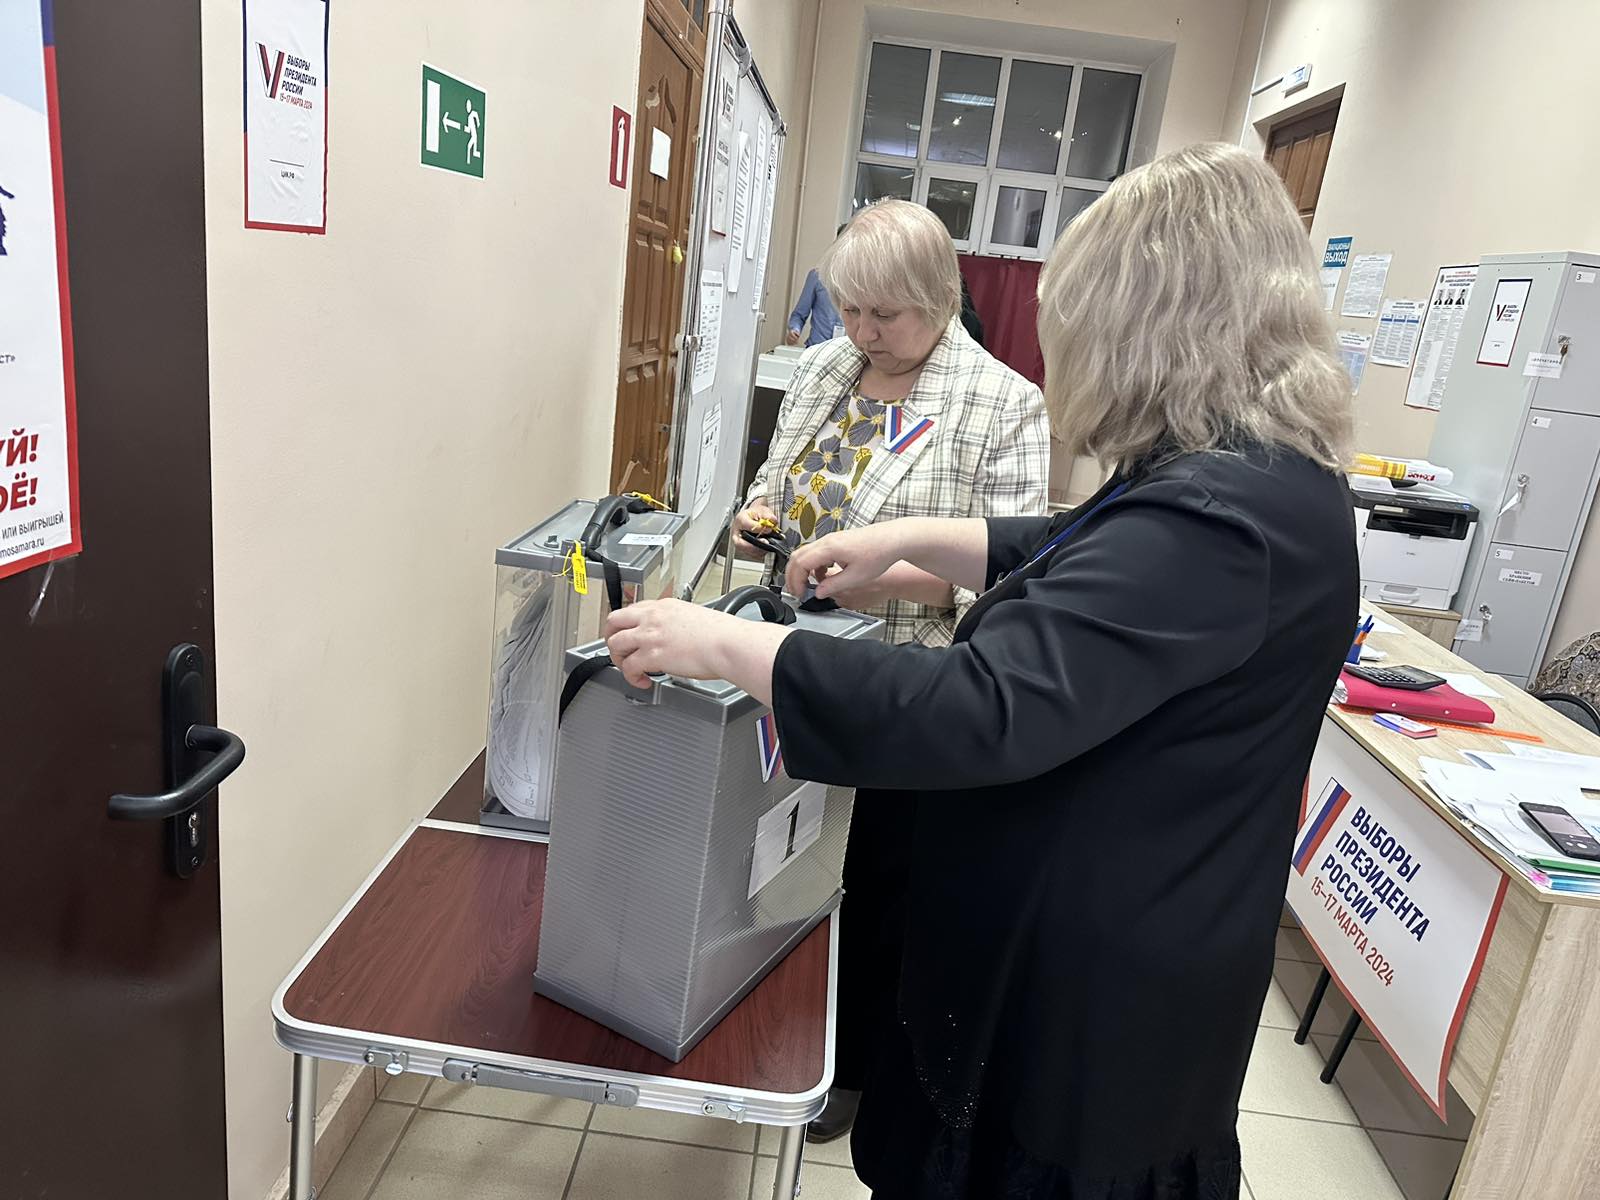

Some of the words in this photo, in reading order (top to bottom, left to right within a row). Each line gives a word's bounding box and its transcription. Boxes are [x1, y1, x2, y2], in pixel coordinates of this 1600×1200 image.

[283, 67, 317, 87] ПРЕЗИДЕНТА
[286, 54, 311, 72] ВЫБОРЫ
[281, 80, 304, 96] РОССИИ
[1324, 251, 1349, 265] ВЫХОД
[1576, 273, 1582, 281] 3
[2, 526, 18, 540] ИЛИ
[19, 511, 65, 536] ВЫИГРЫШЕЙ
[781, 800, 800, 864] 1
[1350, 806, 1421, 883] ВЫБОРЫ
[1320, 853, 1378, 925] РОССИИ
[1335, 830, 1430, 942] ПРЕЗИДЕНТА
[1333, 905, 1369, 955] МАРТА
[1365, 947, 1395, 987] 2024
